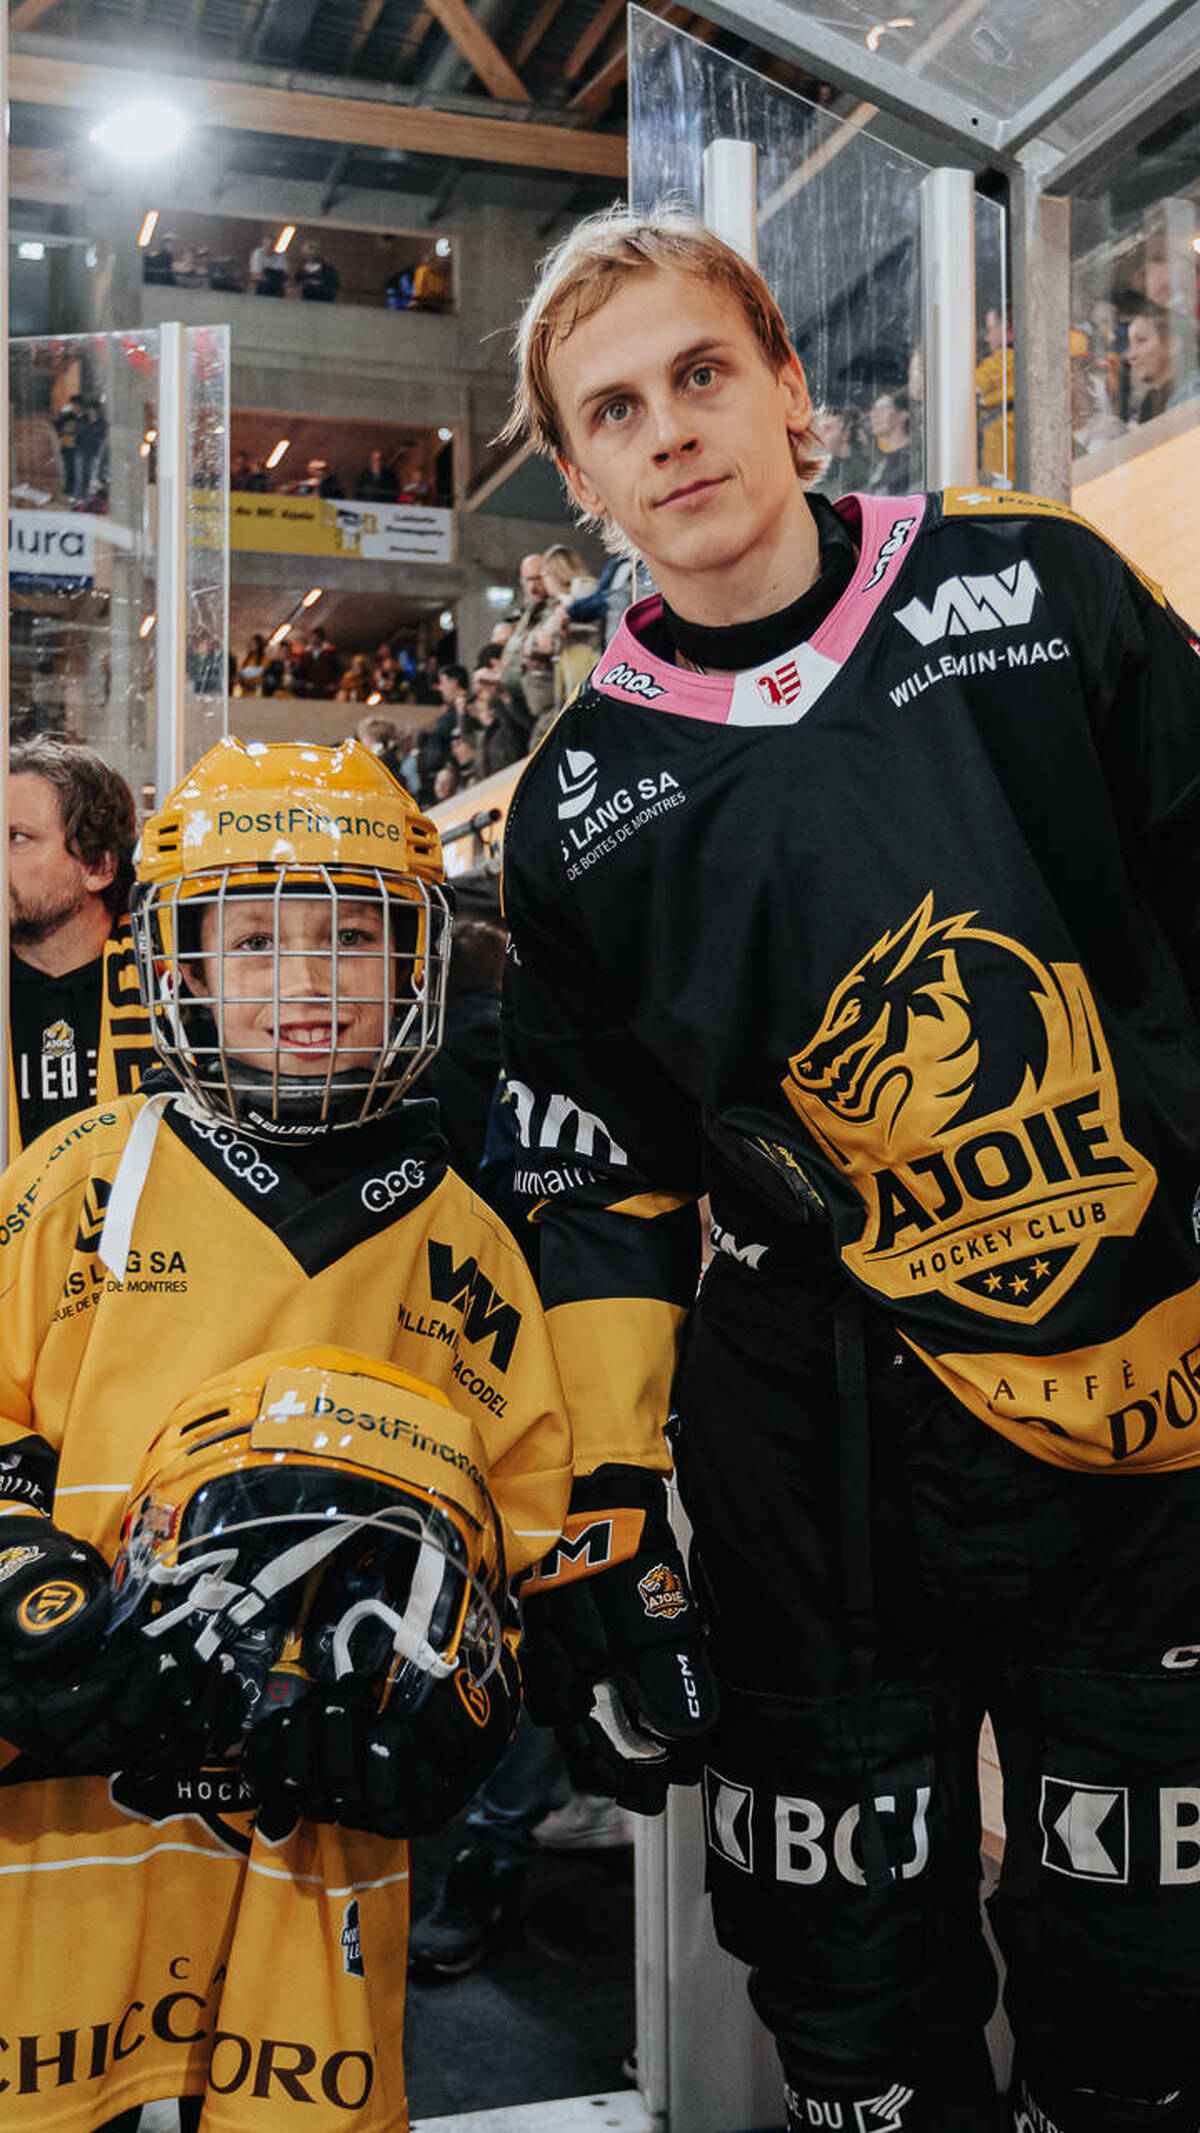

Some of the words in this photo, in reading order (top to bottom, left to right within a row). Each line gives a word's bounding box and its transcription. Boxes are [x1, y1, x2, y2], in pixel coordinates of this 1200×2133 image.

[889, 638, 1071, 708] WILLEMIN-MAC
[218, 808, 401, 842] PostFinance
[569, 788, 634, 850] LANG
[637, 770, 680, 800] SA
[614, 822, 635, 842] DE
[631, 791, 687, 830] MONTRES
[862, 1090, 1134, 1255] AJOIE
[150, 1251, 187, 1274] SA
[909, 1226, 1014, 1280] HOCKEY
[1028, 1201, 1107, 1240] CLUB
[127, 1280, 187, 1293] MONTRES
[677, 1654, 700, 1718] CCM
[806, 2098, 844, 2129] DU
